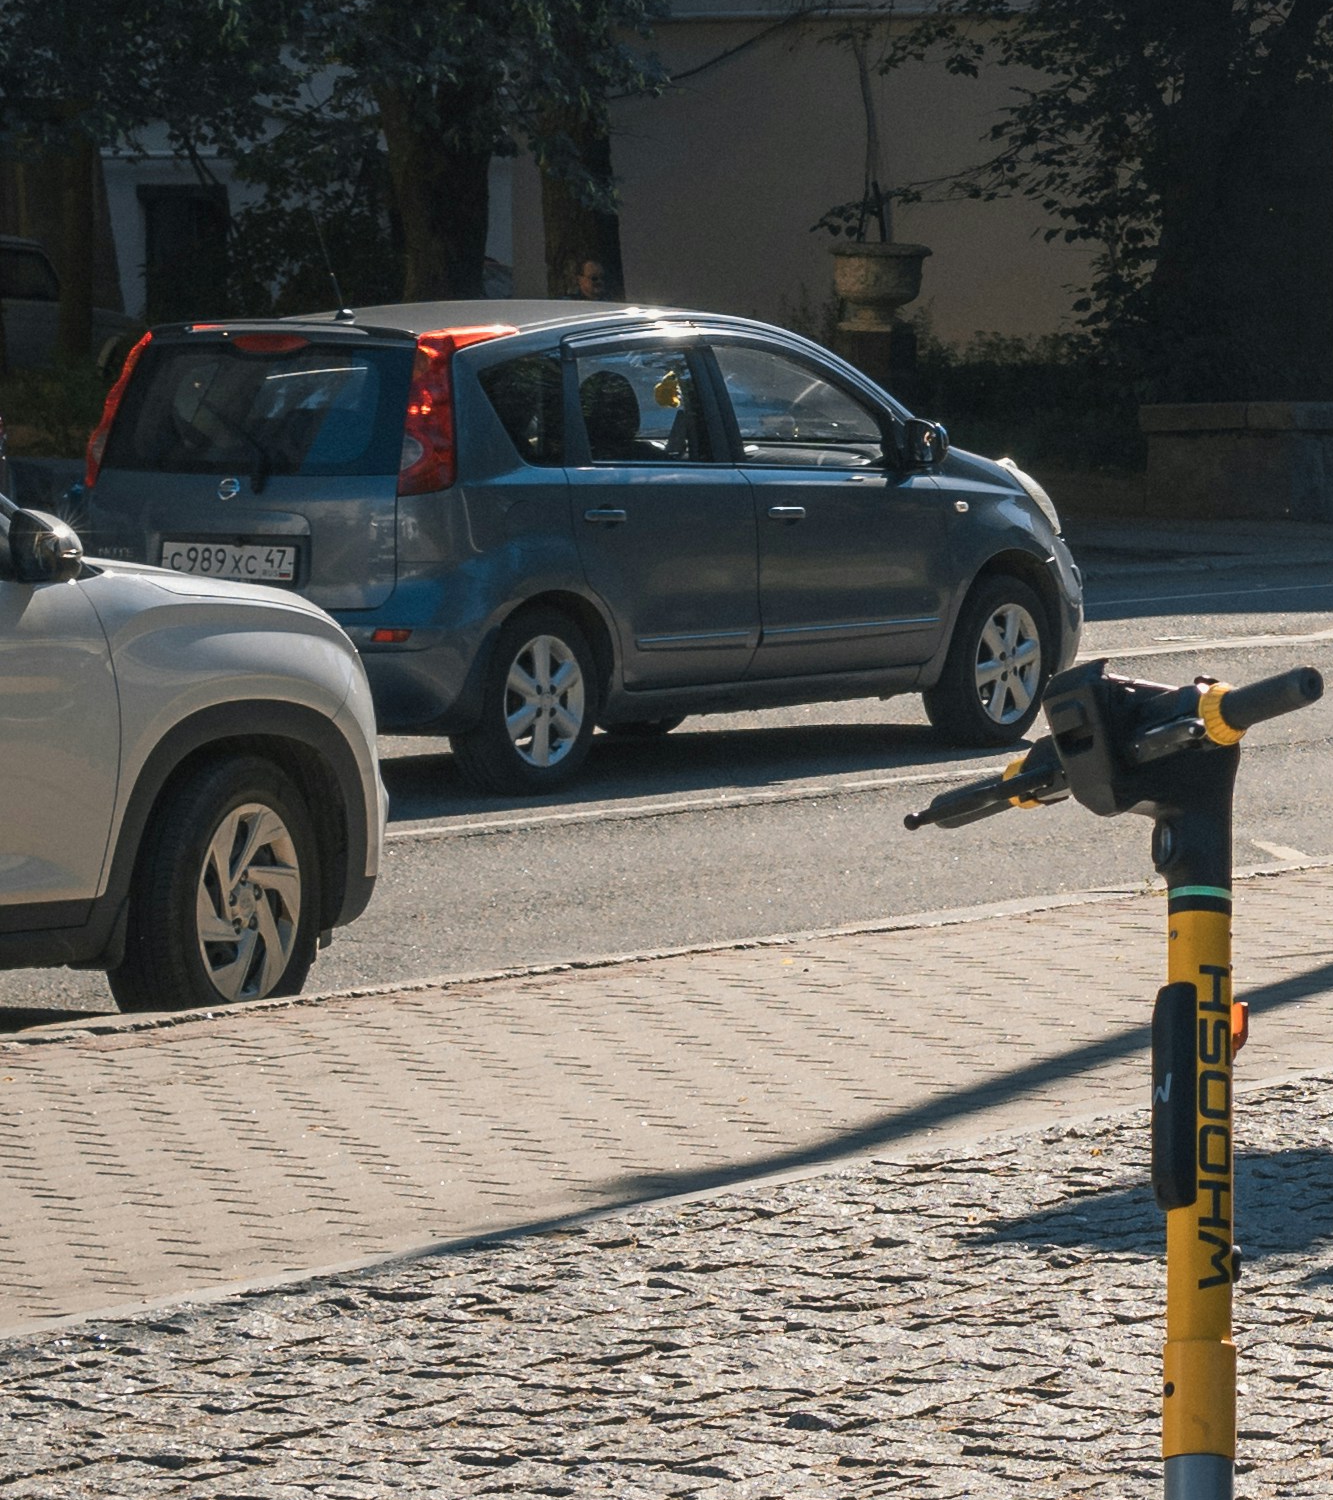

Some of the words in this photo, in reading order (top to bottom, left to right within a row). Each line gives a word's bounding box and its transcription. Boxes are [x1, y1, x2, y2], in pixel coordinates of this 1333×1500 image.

[170, 546, 257, 575] С989ХС
[264, 548, 287, 569] 47
[1197, 964, 1231, 1291] WHOOSH
